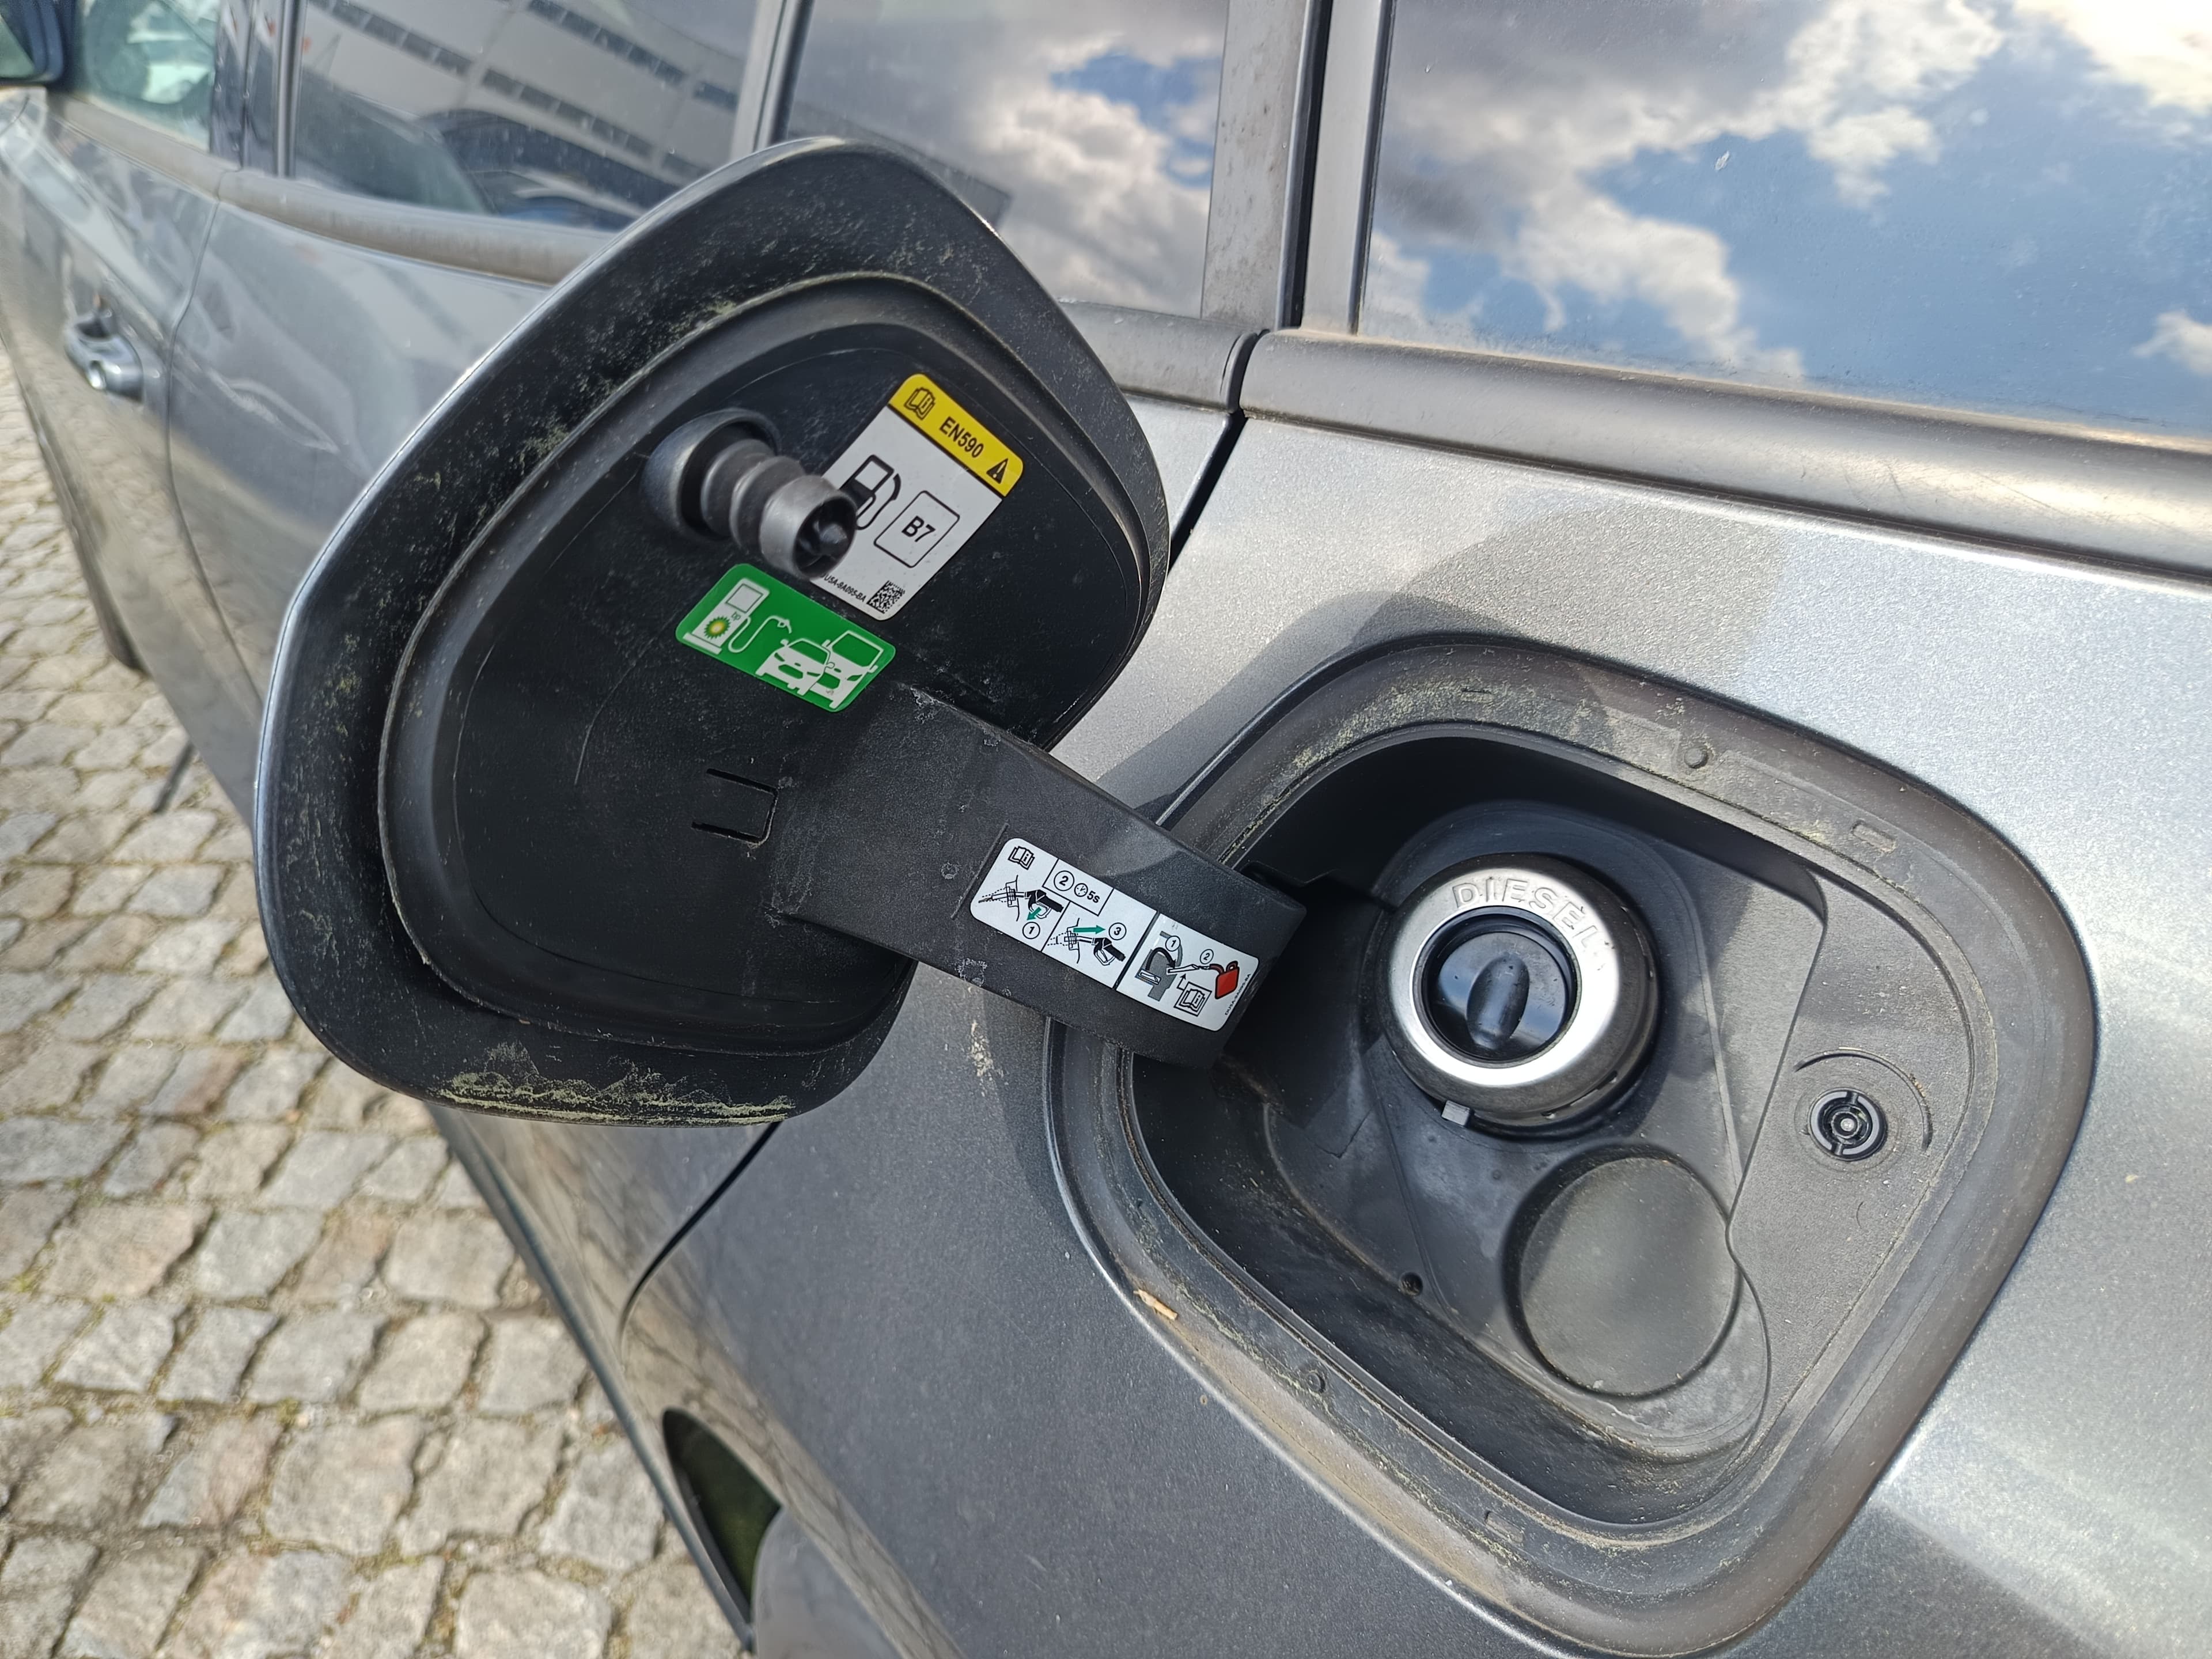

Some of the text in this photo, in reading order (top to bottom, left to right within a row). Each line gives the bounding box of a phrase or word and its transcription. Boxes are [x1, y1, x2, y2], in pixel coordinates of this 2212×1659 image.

[939, 416, 984, 458] EN590
[901, 515, 936, 542] B7
[731, 611, 741, 622] bp
[1086, 891, 1100, 903] 5s
[1452, 877, 1599, 952] DIESEL
